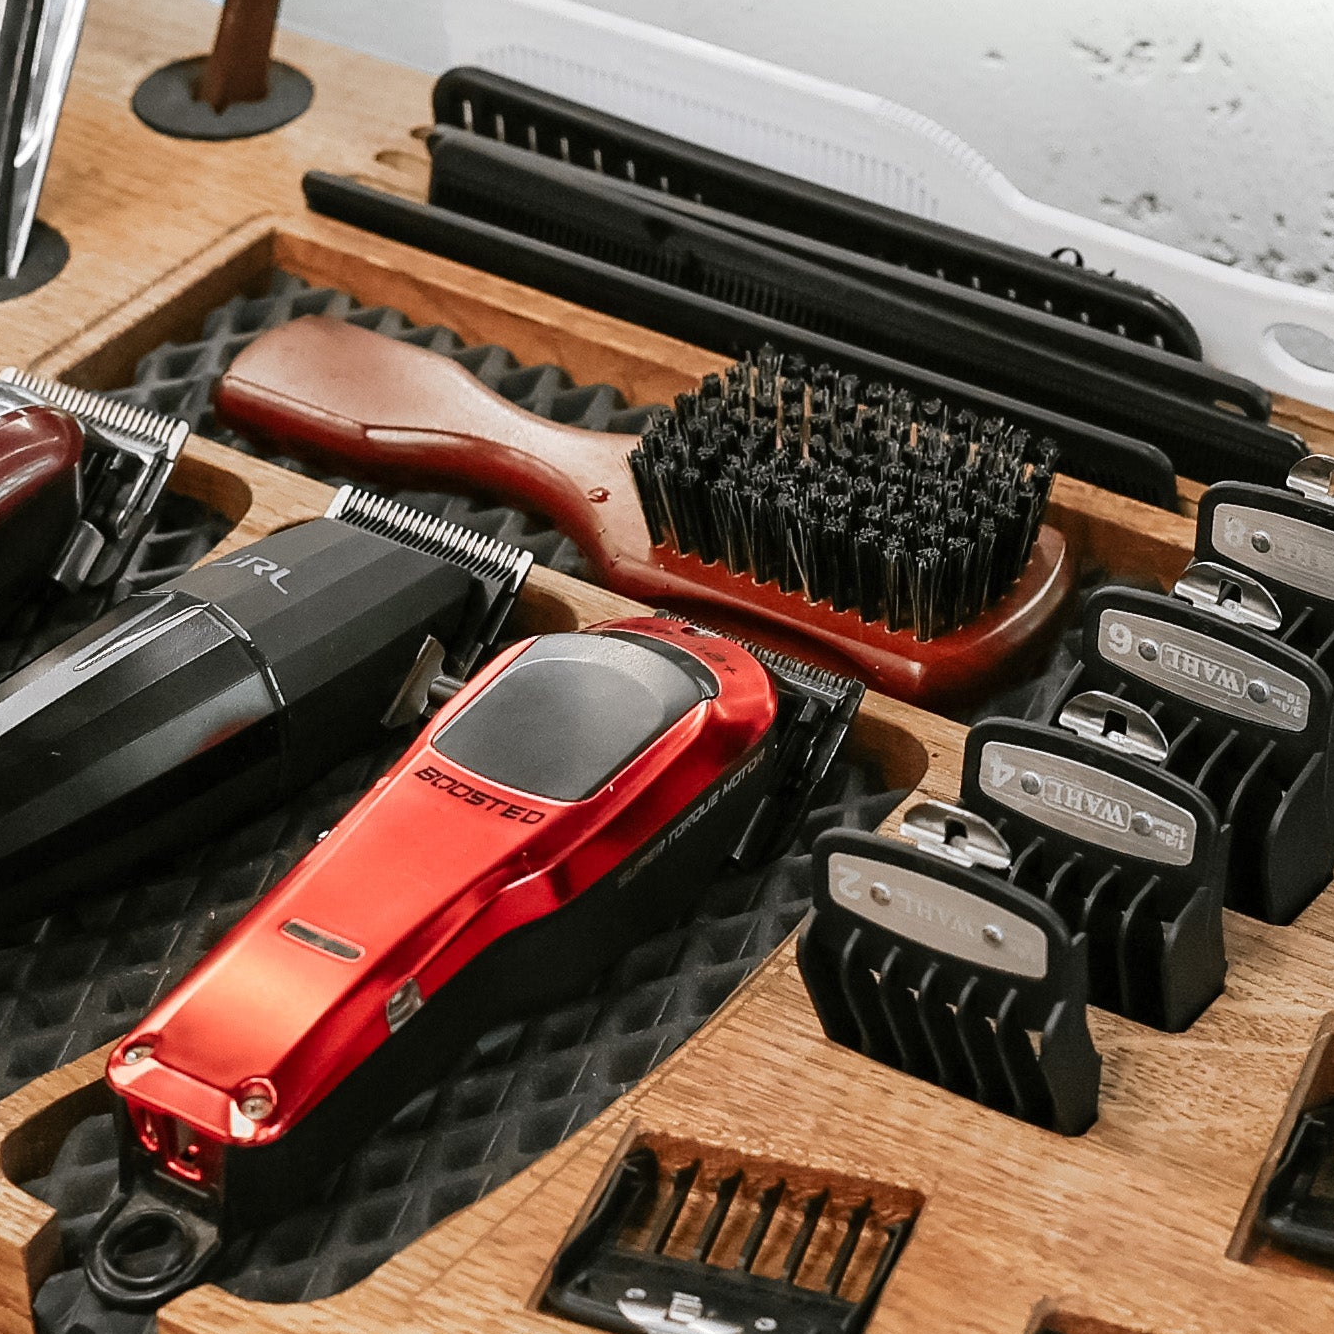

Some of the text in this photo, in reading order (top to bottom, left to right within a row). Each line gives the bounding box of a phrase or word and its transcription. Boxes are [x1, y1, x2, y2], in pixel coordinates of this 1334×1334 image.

[1108, 621, 1135, 655] 6
[1165, 648, 1242, 694] WAHL
[989, 752, 1015, 787] 4
[414, 765, 546, 825] BOOSTED
[669, 790, 720, 845] TORQUE
[722, 747, 765, 796] MOTOR
[1046, 782, 1126, 828] WAHL
[834, 866, 862, 900] 2
